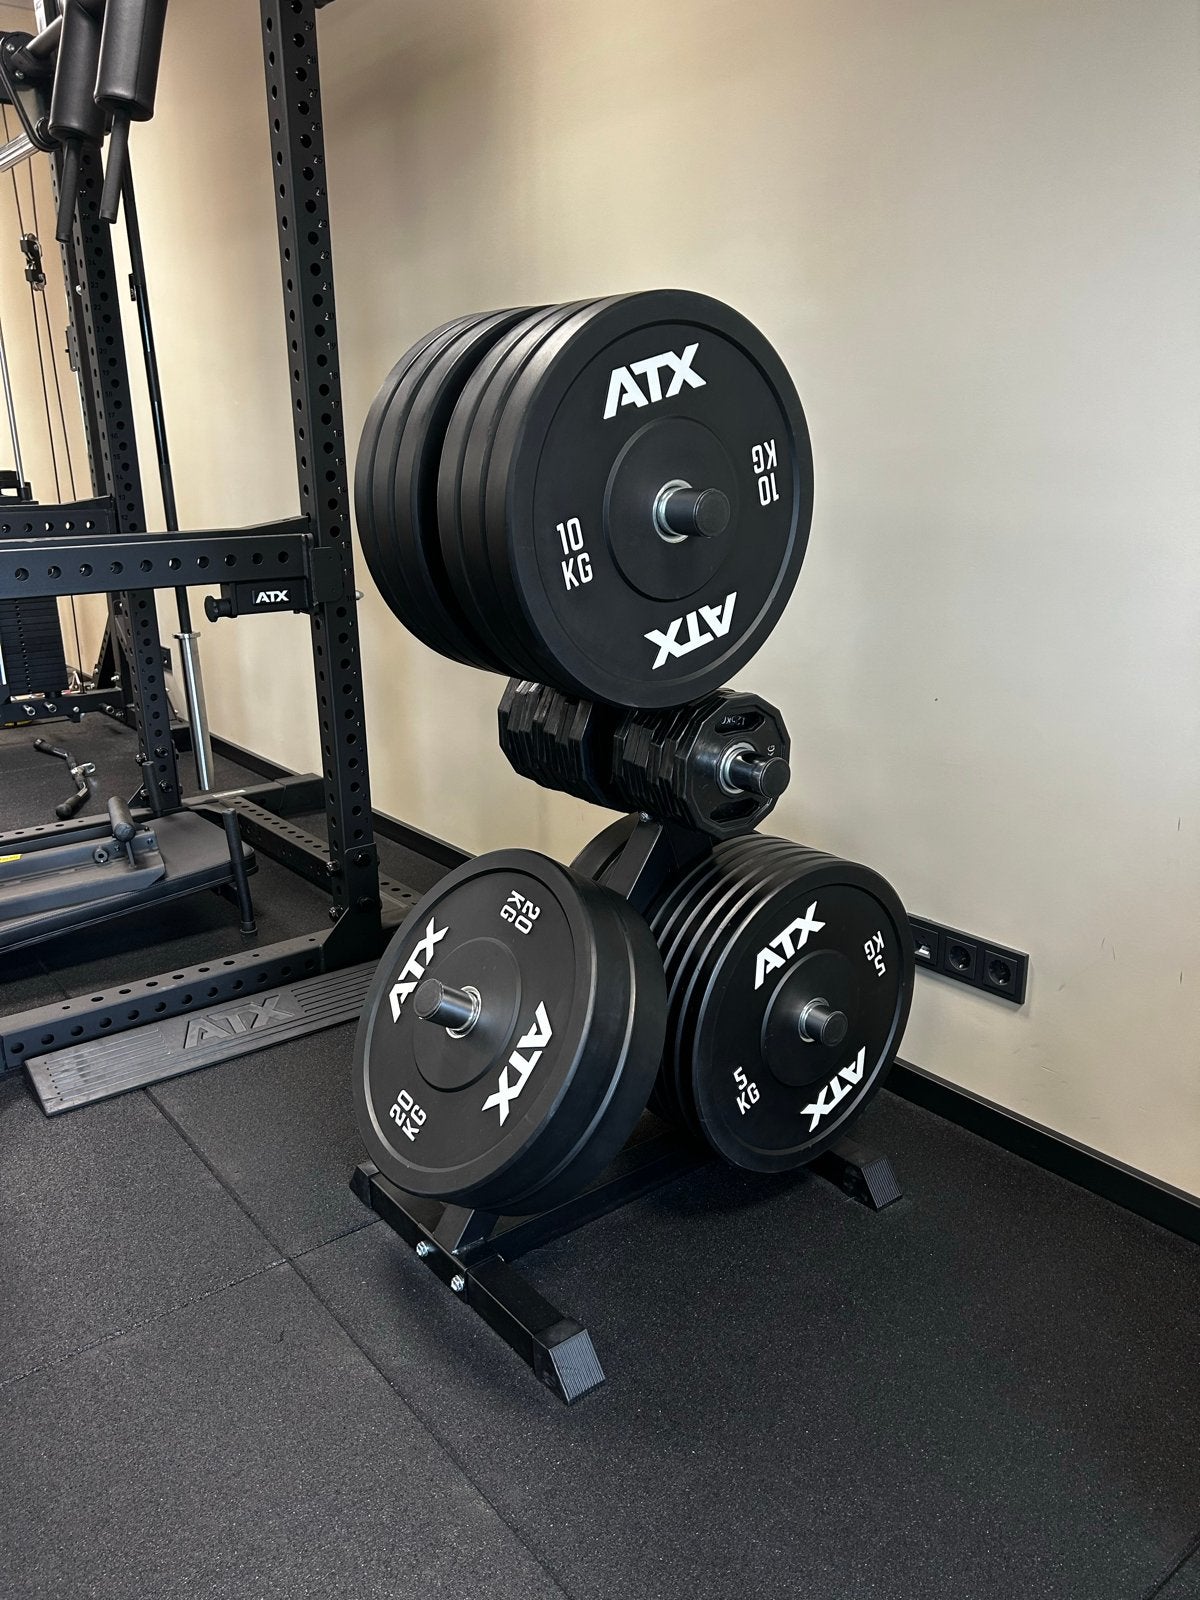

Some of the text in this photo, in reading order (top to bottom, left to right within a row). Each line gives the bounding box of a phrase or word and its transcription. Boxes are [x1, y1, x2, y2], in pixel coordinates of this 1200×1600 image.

[603, 342, 706, 420] ATX
[751, 439, 778, 474] KG
[757, 472, 780, 506] 10
[556, 516, 584, 556] 10
[560, 552, 594, 591] KG
[256, 590, 290, 604] ATX
[644, 591, 737, 670] ATX
[500, 890, 526, 924] KG
[514, 898, 542, 936] 20
[754, 900, 826, 990] ATX
[864, 930, 885, 962] KG
[388, 916, 450, 1024] ATX
[874, 954, 886, 977] 5
[183, 994, 295, 1050] ATX
[481, 1000, 553, 1127] ATX
[733, 1066, 748, 1091] 5
[388, 1088, 414, 1127] 20
[736, 1082, 760, 1115] KG
[800, 1046, 866, 1132] ATX
[401, 1108, 428, 1142] KG
